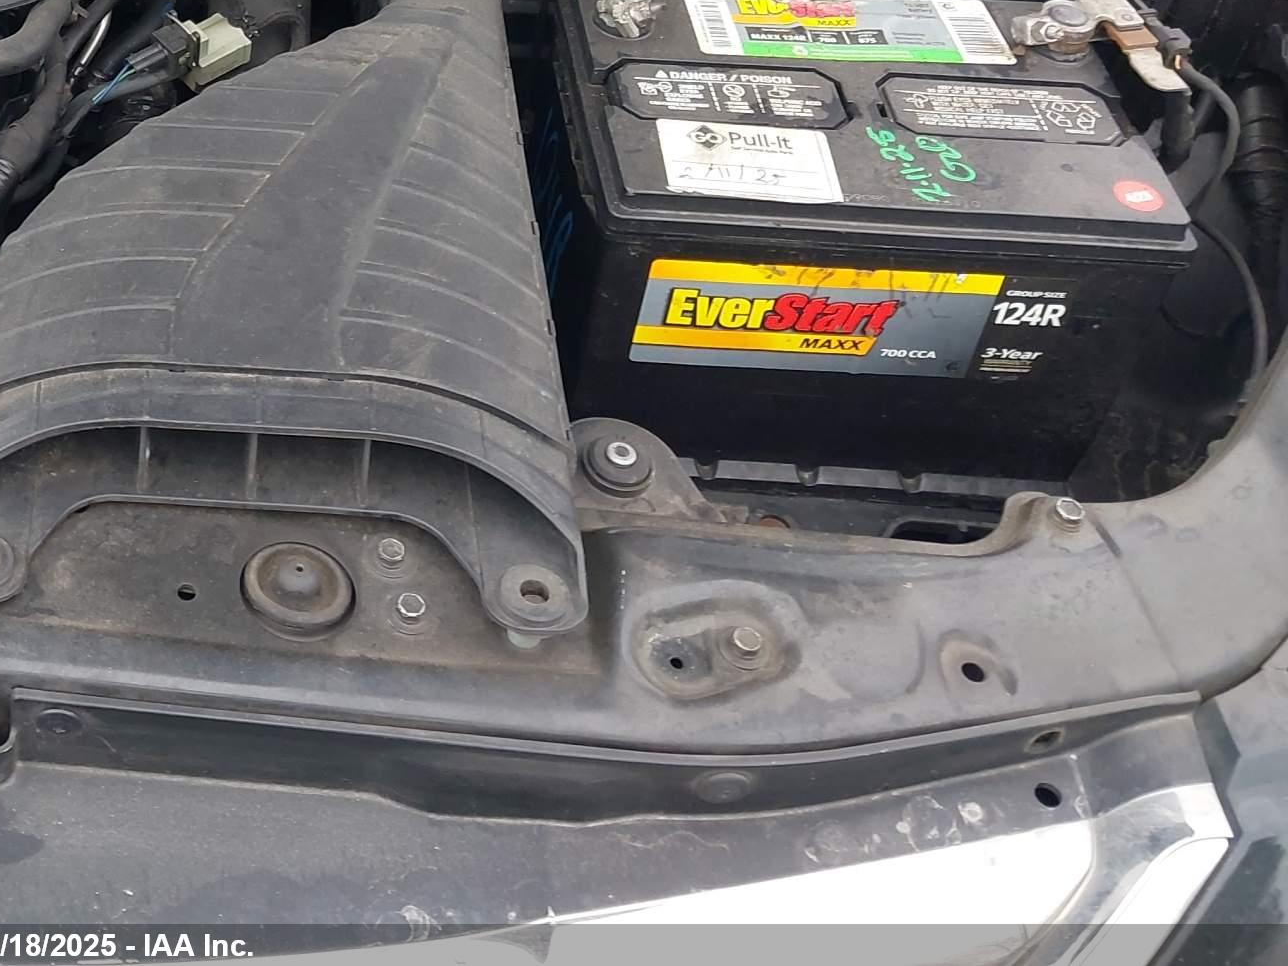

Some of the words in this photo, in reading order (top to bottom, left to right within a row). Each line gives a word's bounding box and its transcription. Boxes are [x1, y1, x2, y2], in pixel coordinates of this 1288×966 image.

[669, 71, 726, 82] DANGER
[739, 74, 793, 84] POISON
[728, 131, 793, 150] Pull-It
[665, 287, 900, 335] EverStart
[991, 302, 1064, 328] 124R
[799, 337, 863, 352] MAXX
[880, 349, 907, 358] 700
[908, 350, 937, 360] CCA
[980, 347, 1044, 360] 3-Year
